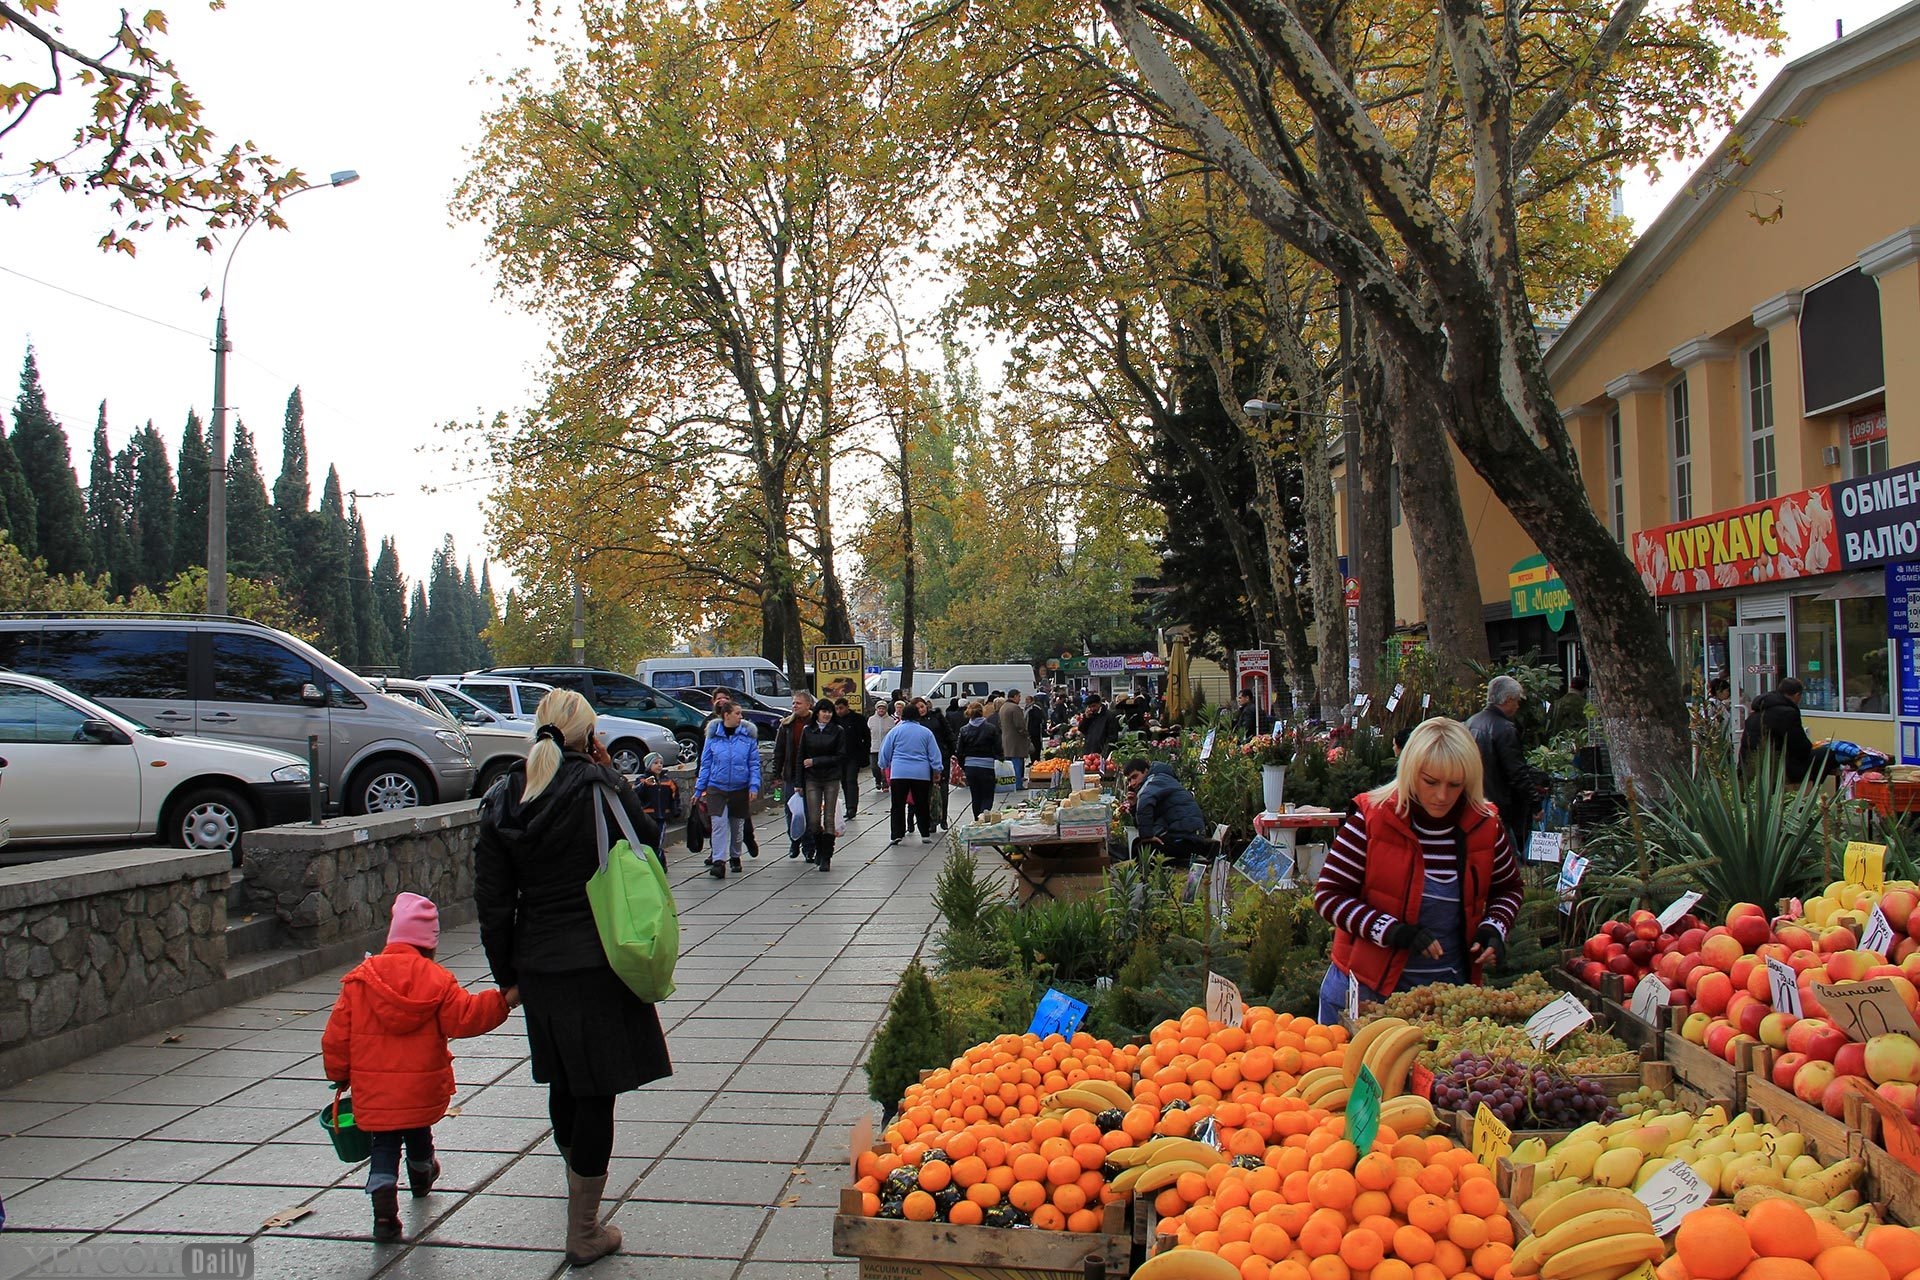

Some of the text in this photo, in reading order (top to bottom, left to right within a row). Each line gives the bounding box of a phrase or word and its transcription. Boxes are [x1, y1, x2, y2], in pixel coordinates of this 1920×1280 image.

[1665, 508, 1779, 572] КУРХАУС
[864, 1263, 922, 1276] VACUUM PACK
